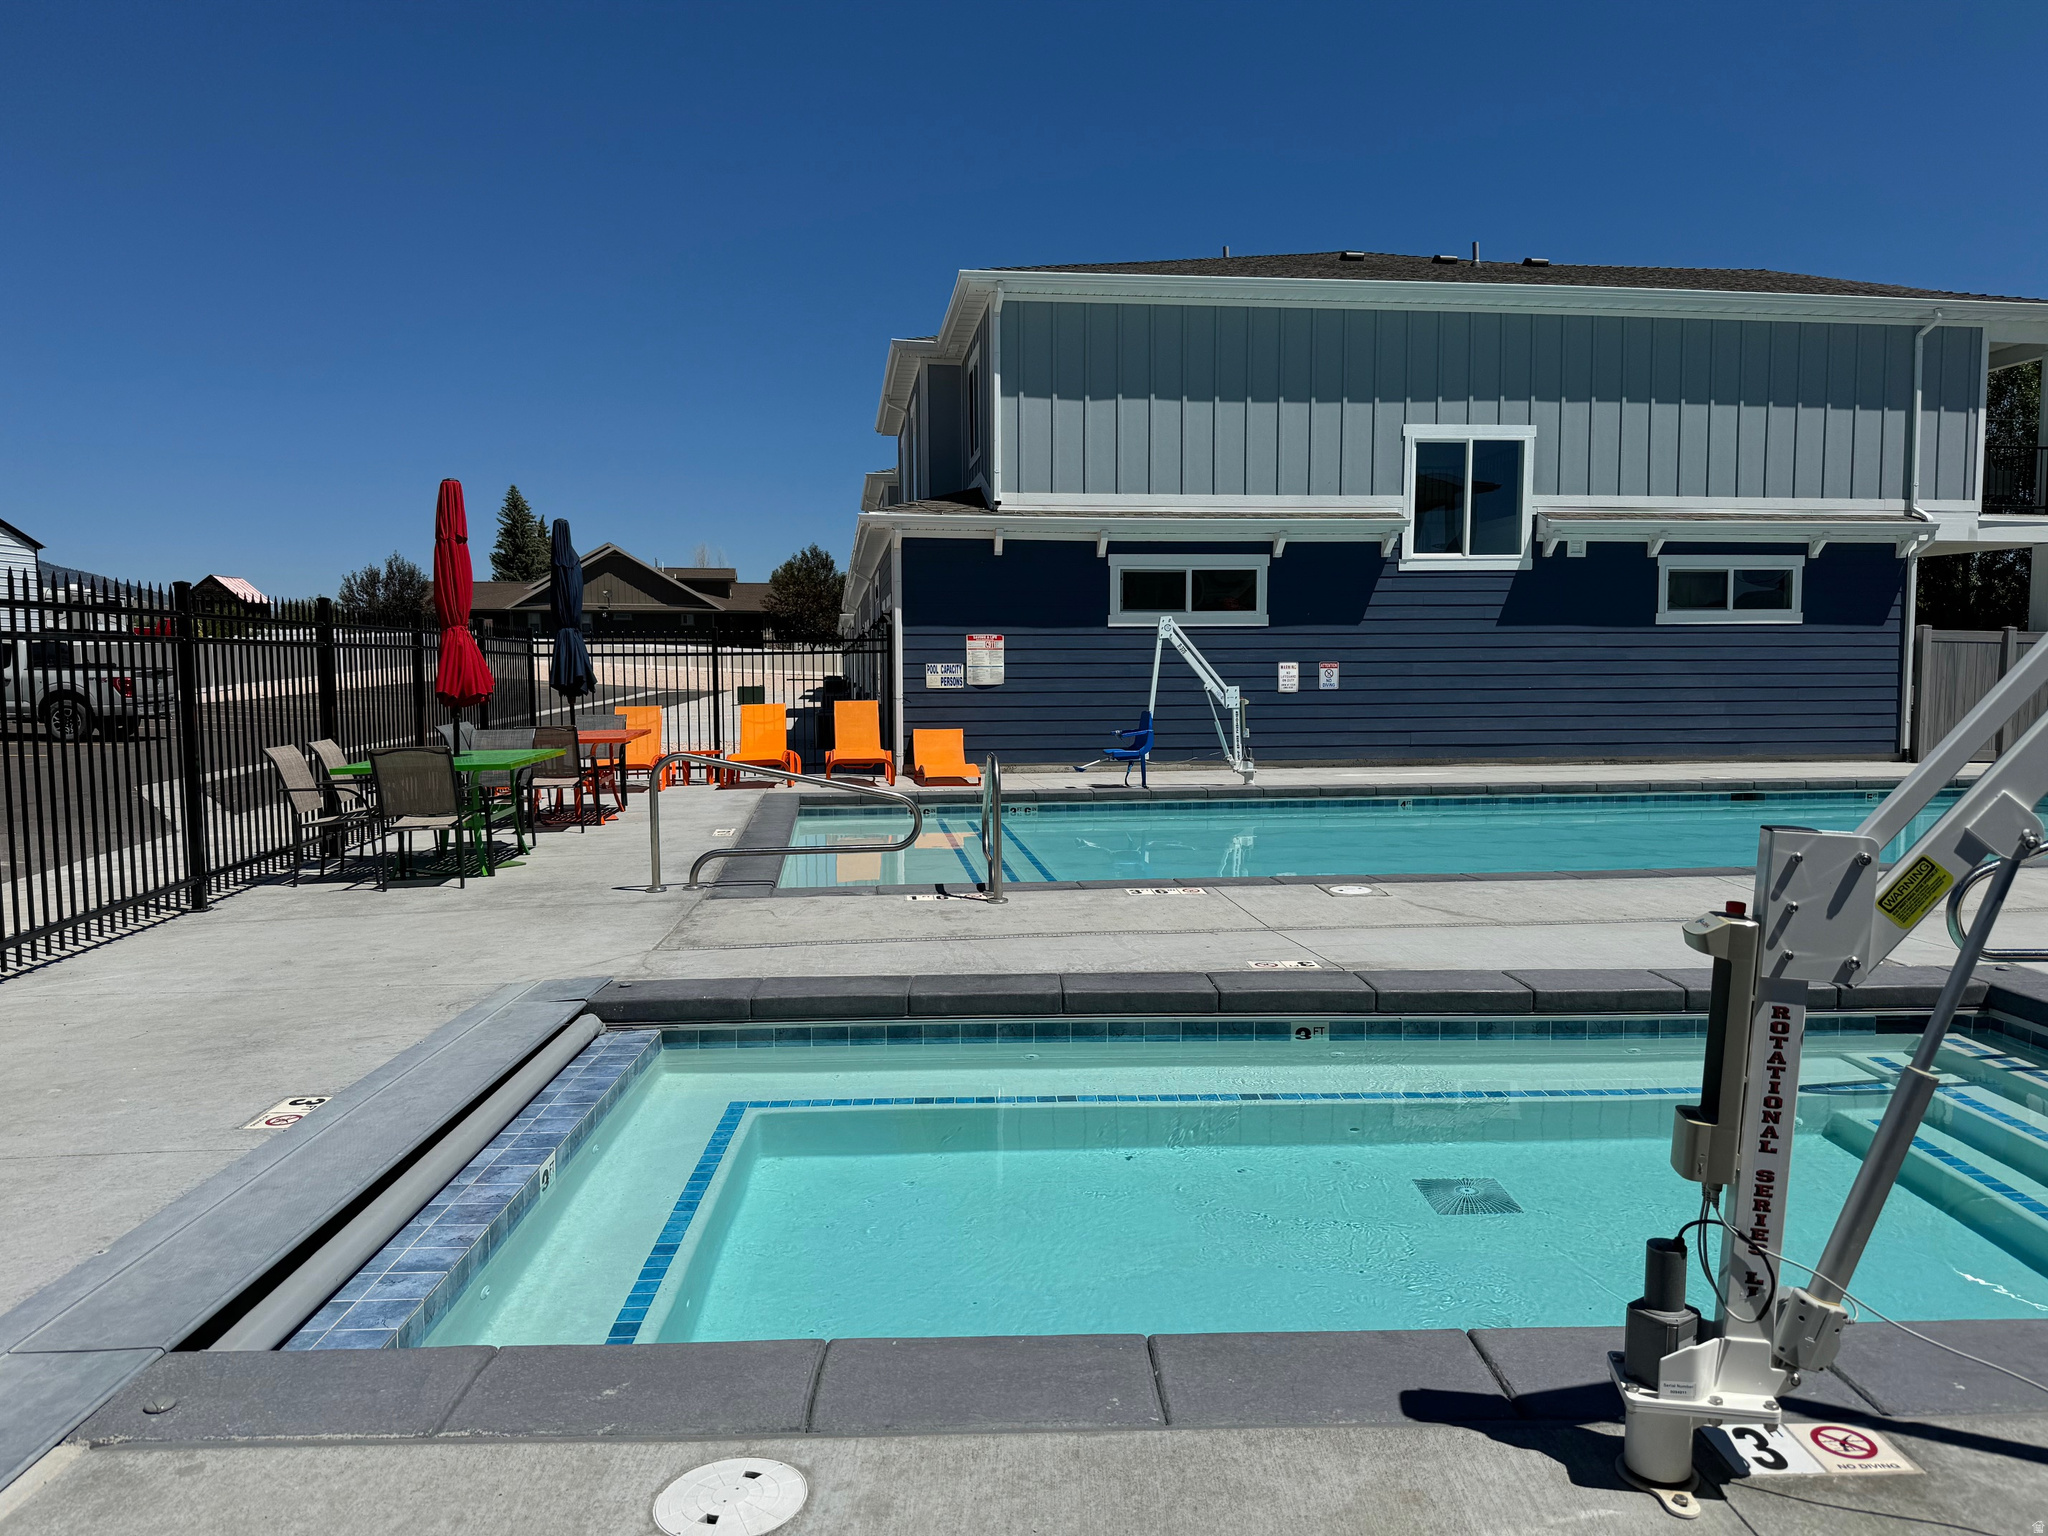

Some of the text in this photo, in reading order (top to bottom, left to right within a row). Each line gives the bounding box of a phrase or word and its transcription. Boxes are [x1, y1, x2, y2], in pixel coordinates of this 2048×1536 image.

[927, 665, 962, 674] POOL CAPACITY
[941, 677, 962, 686] PERSONS
[1884, 862, 1930, 907] WARNING
[1295, 1027, 1325, 1040] 3 FT
[1758, 1006, 1790, 1154] ROTATIONAL
[1748, 1170, 1775, 1255] SERIES
[1732, 1427, 1788, 1470] 3
